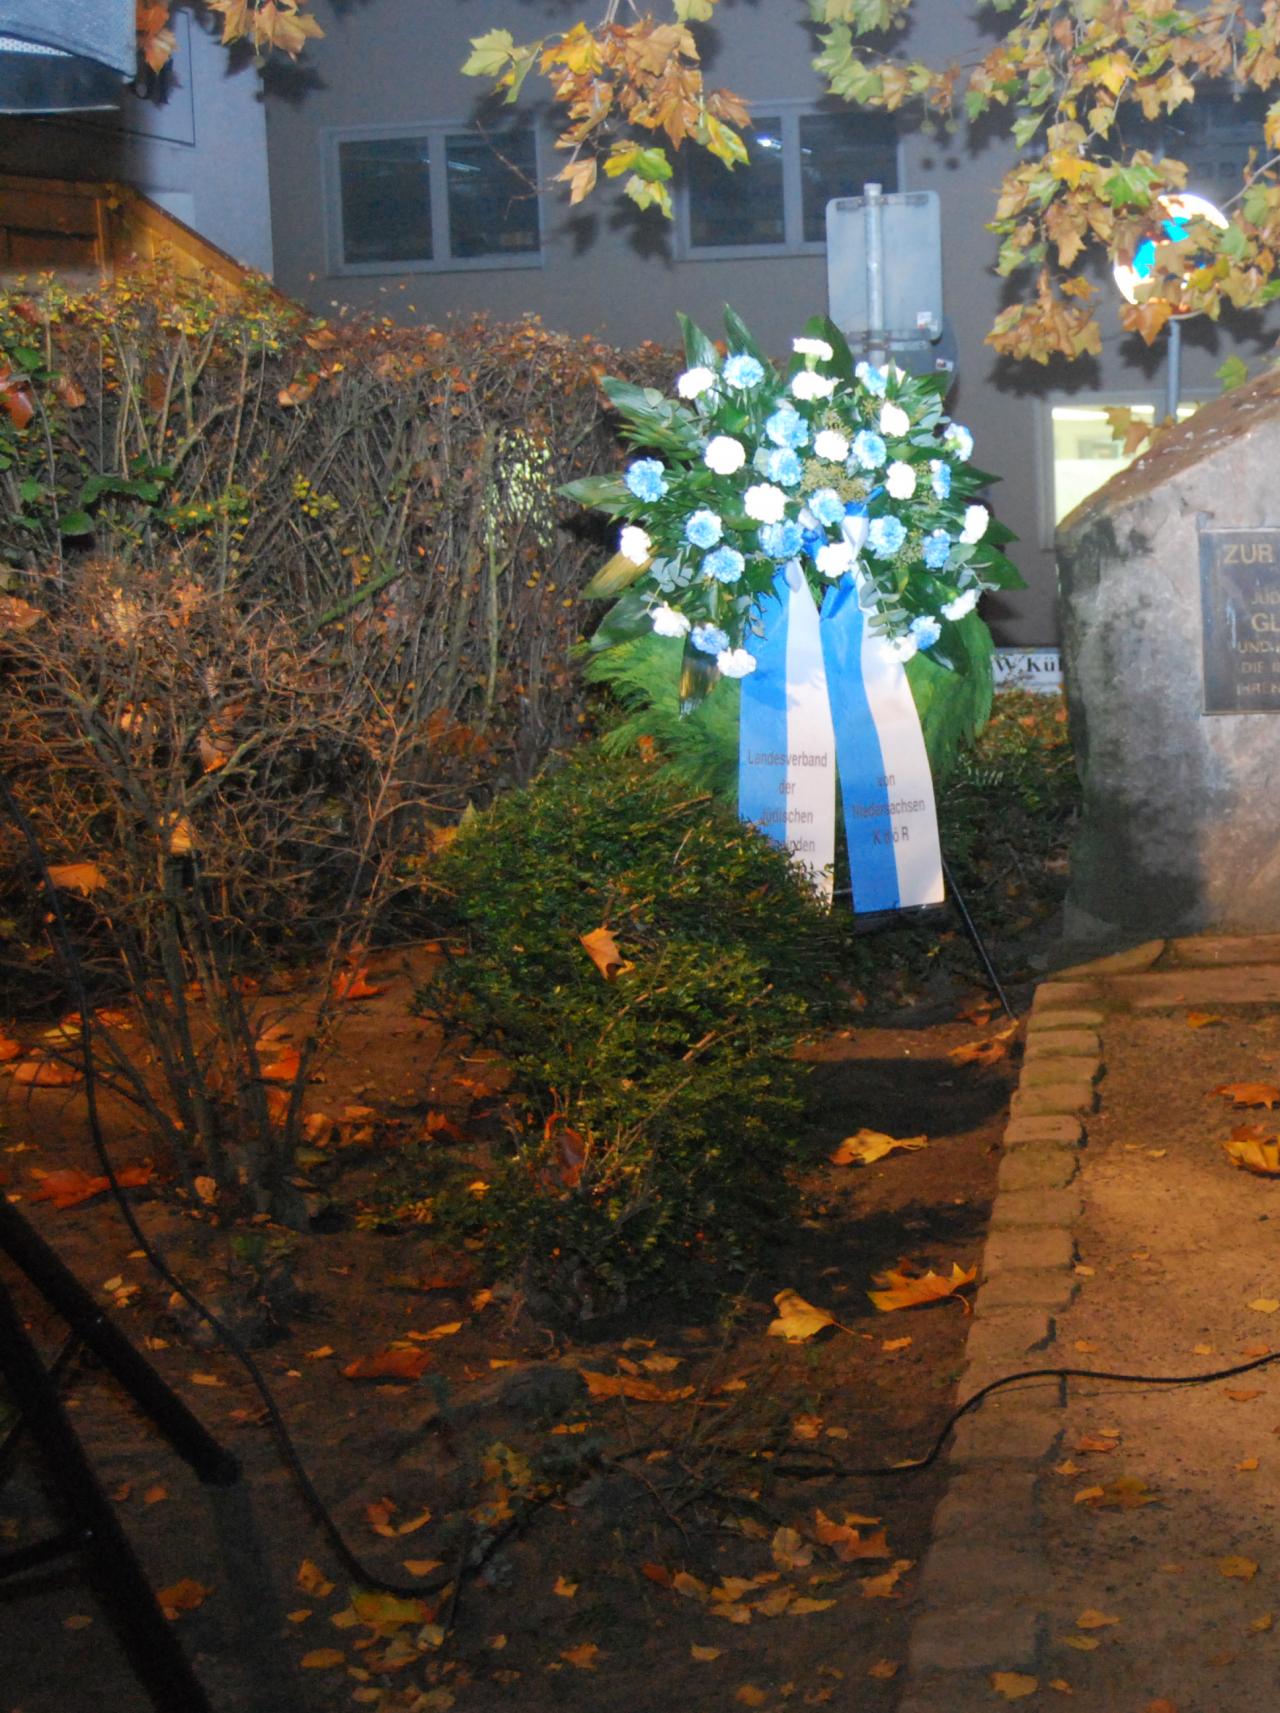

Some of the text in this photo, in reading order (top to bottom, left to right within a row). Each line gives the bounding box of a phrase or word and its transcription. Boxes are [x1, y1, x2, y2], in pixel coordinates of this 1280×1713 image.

[1223, 543, 1273, 564] ZUR
[747, 751, 828, 768] Landesverband
[778, 780, 797, 795] der
